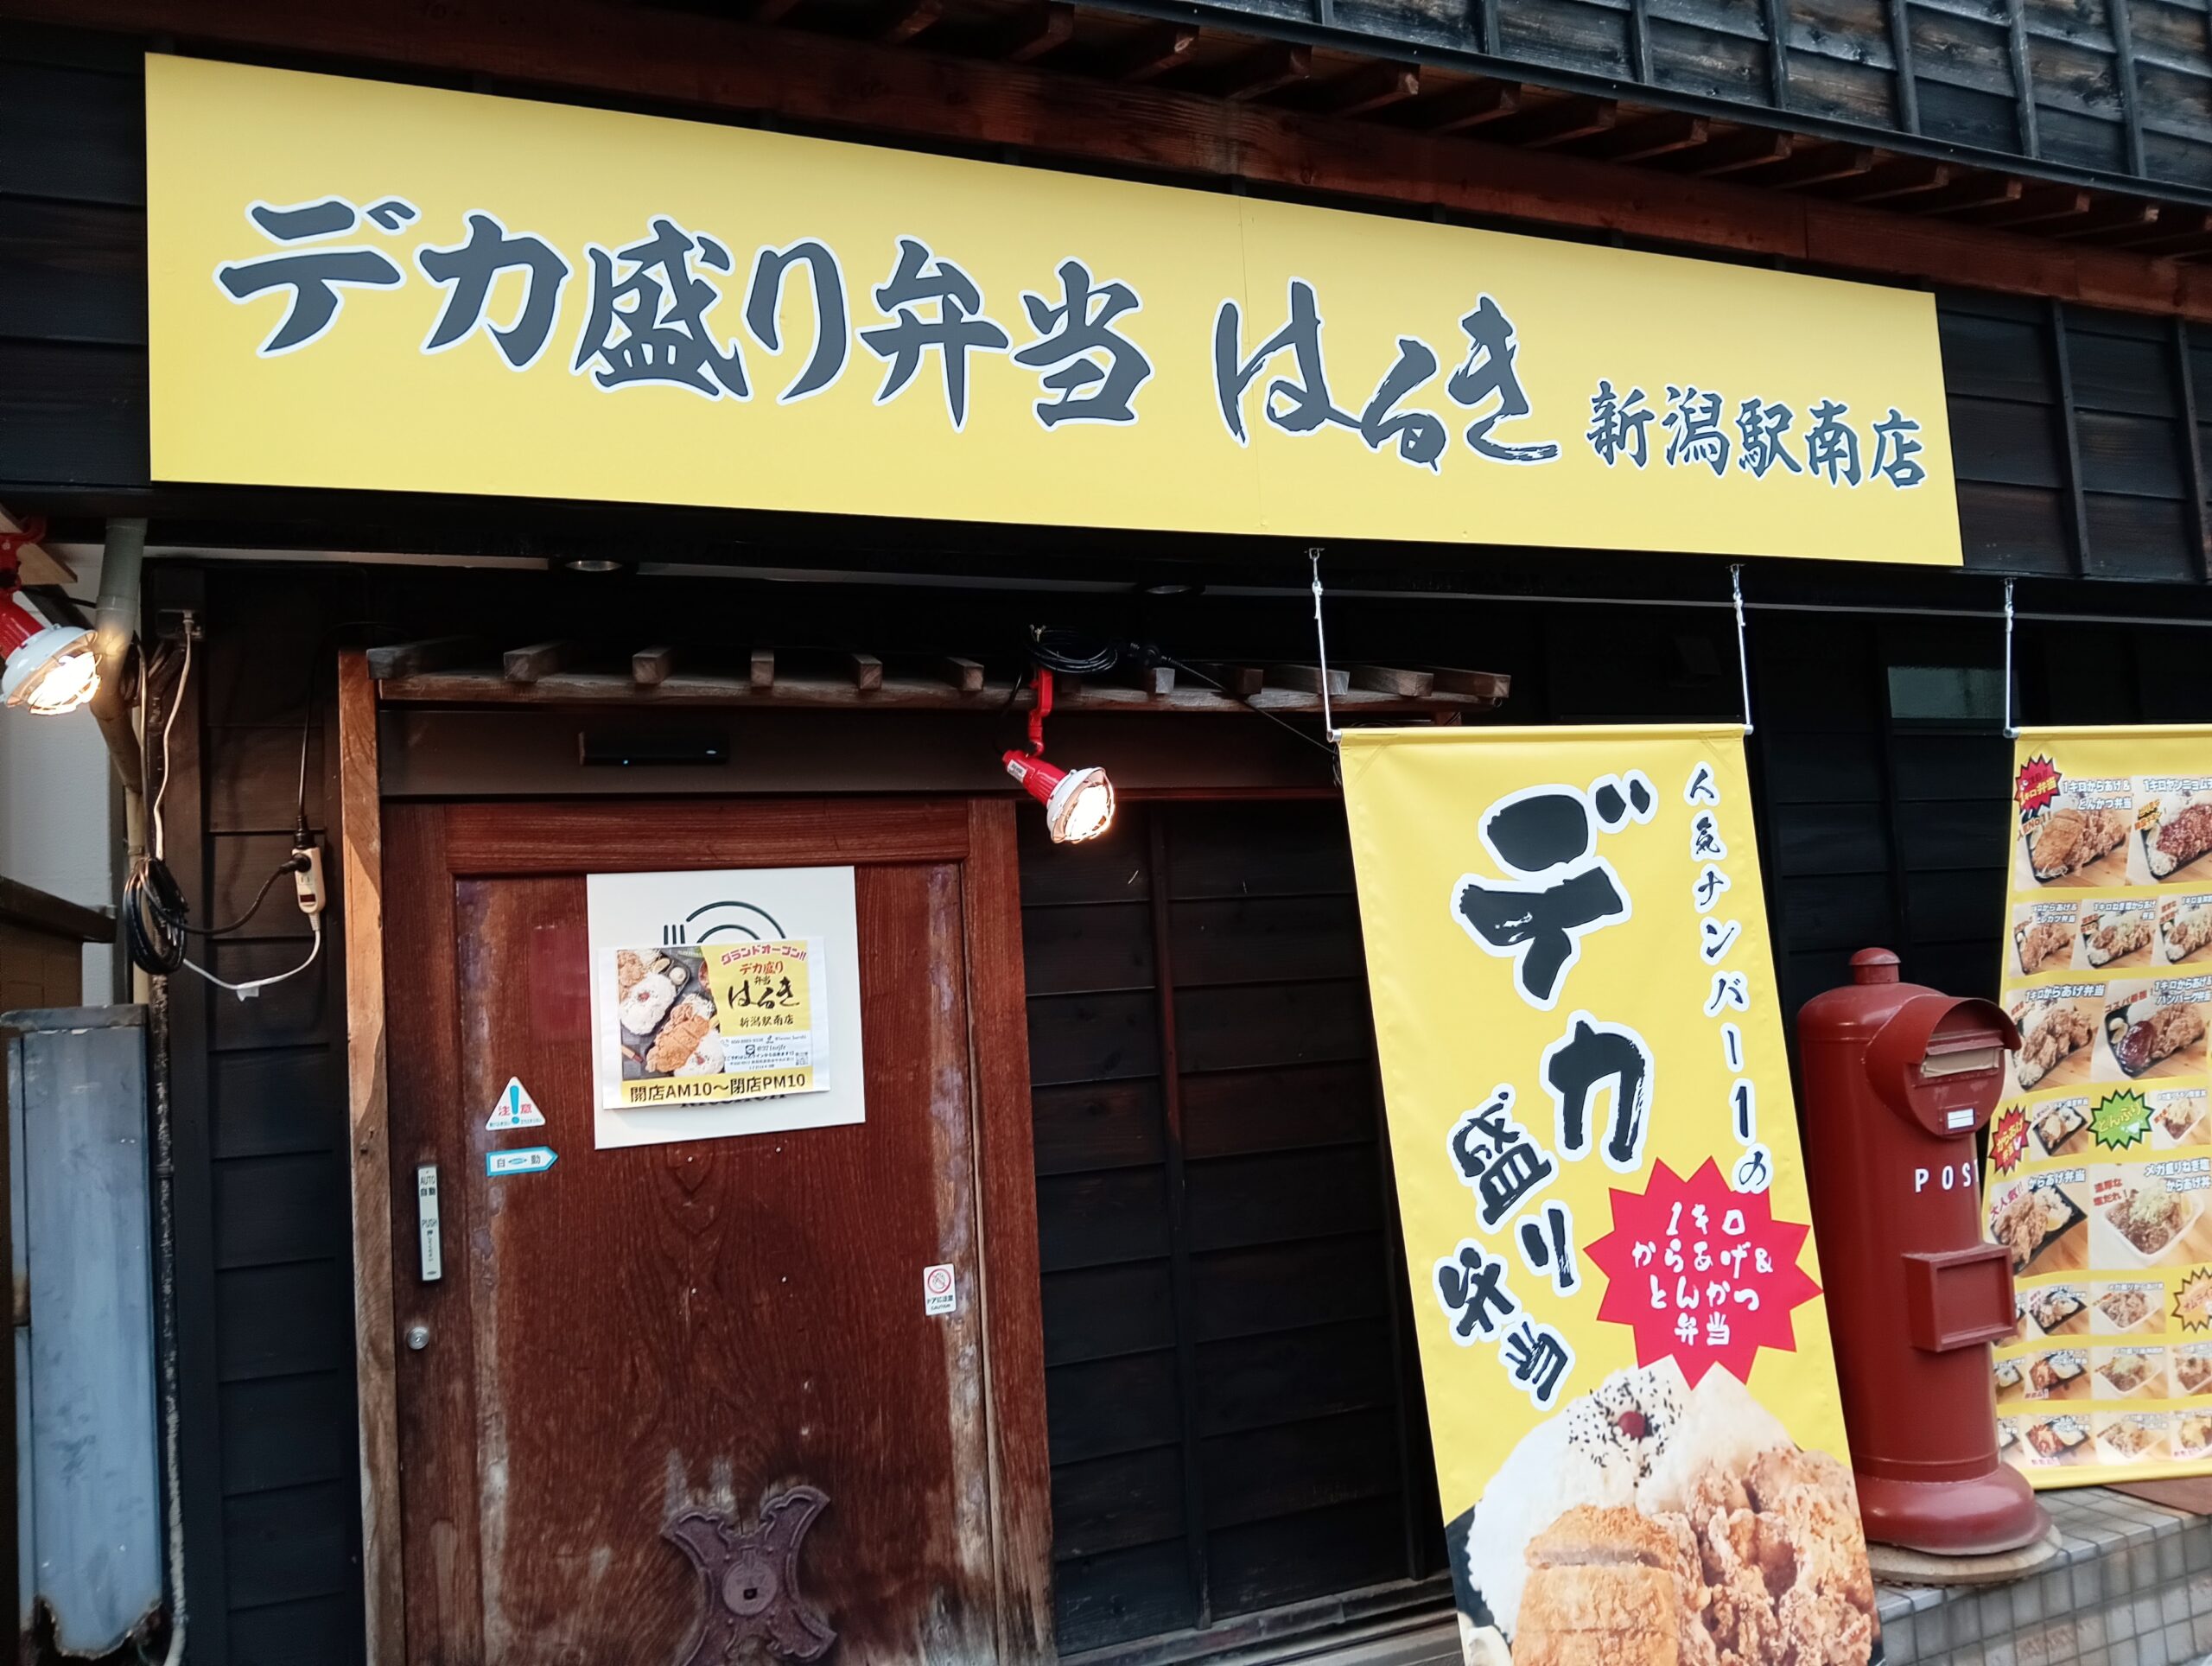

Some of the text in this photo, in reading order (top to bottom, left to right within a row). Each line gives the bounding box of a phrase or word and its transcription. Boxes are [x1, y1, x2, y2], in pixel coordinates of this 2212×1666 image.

[216, 198, 1927, 489] デカ盛り弁当 はるき 新潟駅南店
[740, 960, 784, 975] デカ盛り
[753, 976, 772, 985] 弁当
[1688, 766, 1768, 1187] 人気ナンバー1の
[728, 976, 801, 1009] はるき
[740, 1014, 794, 1028] 新潟駅南店
[1665, 1200, 1747, 1237] 1キロ
[1631, 1239, 1774, 1280] からあげ&
[1649, 1274, 1761, 1312] とんかつ
[1673, 1312, 1732, 1347] 弁当
